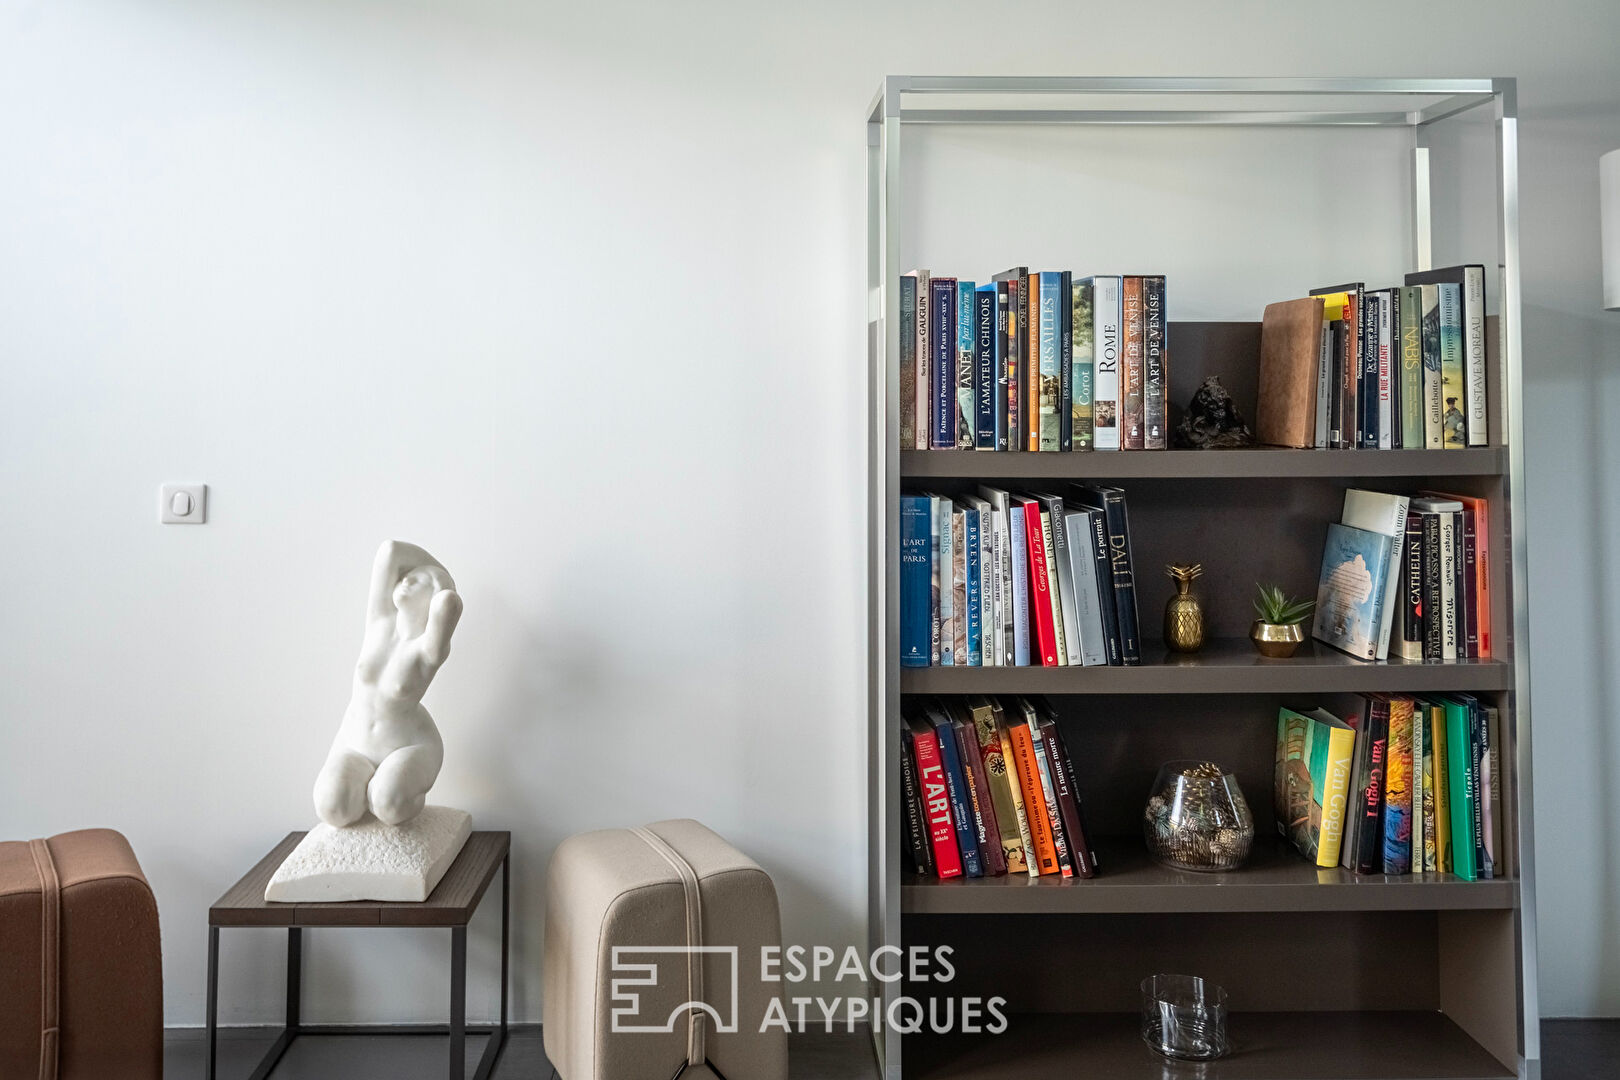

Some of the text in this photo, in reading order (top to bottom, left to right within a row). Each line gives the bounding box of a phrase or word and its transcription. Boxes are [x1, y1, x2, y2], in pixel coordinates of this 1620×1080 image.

[918, 296, 926, 336] GAUGUIN
[1442, 288, 1456, 362] Impressionnisme
[981, 298, 990, 414] L'AMATEUR CHINOIS
[1044, 297, 1054, 382] VERSAILLES
[1128, 294, 1138, 396] L'ART DE VENISE
[1150, 294, 1160, 396] L'ART DE VENISE
[1404, 326, 1420, 370] NABIS
[960, 350, 972, 400] MANET
[1078, 370, 1090, 406] Corot
[1366, 363, 1373, 373] De
[1380, 344, 1388, 400] LA RUE MILITANTE
[1472, 316, 1484, 420] GUSTAVE MOREAU
[1432, 379, 1440, 424] Caillebotte
[903, 538, 926, 546] L'ART
[941, 520, 952, 554] Signac
[970, 526, 978, 566] BRYEN
[1054, 504, 1064, 549] Giacometti
[1094, 518, 1106, 560] Le portrait
[1392, 504, 1408, 557] Zoum Walter
[1032, 526, 1046, 591] Georges de La Tour
[1110, 534, 1132, 576] DALÍ
[1410, 541, 1420, 604] CATHELIN
[1444, 524, 1454, 648] Georges Rouault Miserere
[1432, 590, 1440, 656] RETROSPECTIVE
[1048, 737, 1069, 797] La nature morte
[1372, 739, 1386, 764] Van
[902, 758, 914, 798] CHINOISE
[922, 765, 952, 825] L'ART
[1322, 758, 1350, 842] Van Gogh
[1365, 768, 1383, 806] Gogh
[908, 798, 920, 838] PEINTURE
[1032, 806, 1044, 835] fauvisme
[1038, 836, 1046, 844] Le
[1055, 832, 1068, 858] VIEIRA
